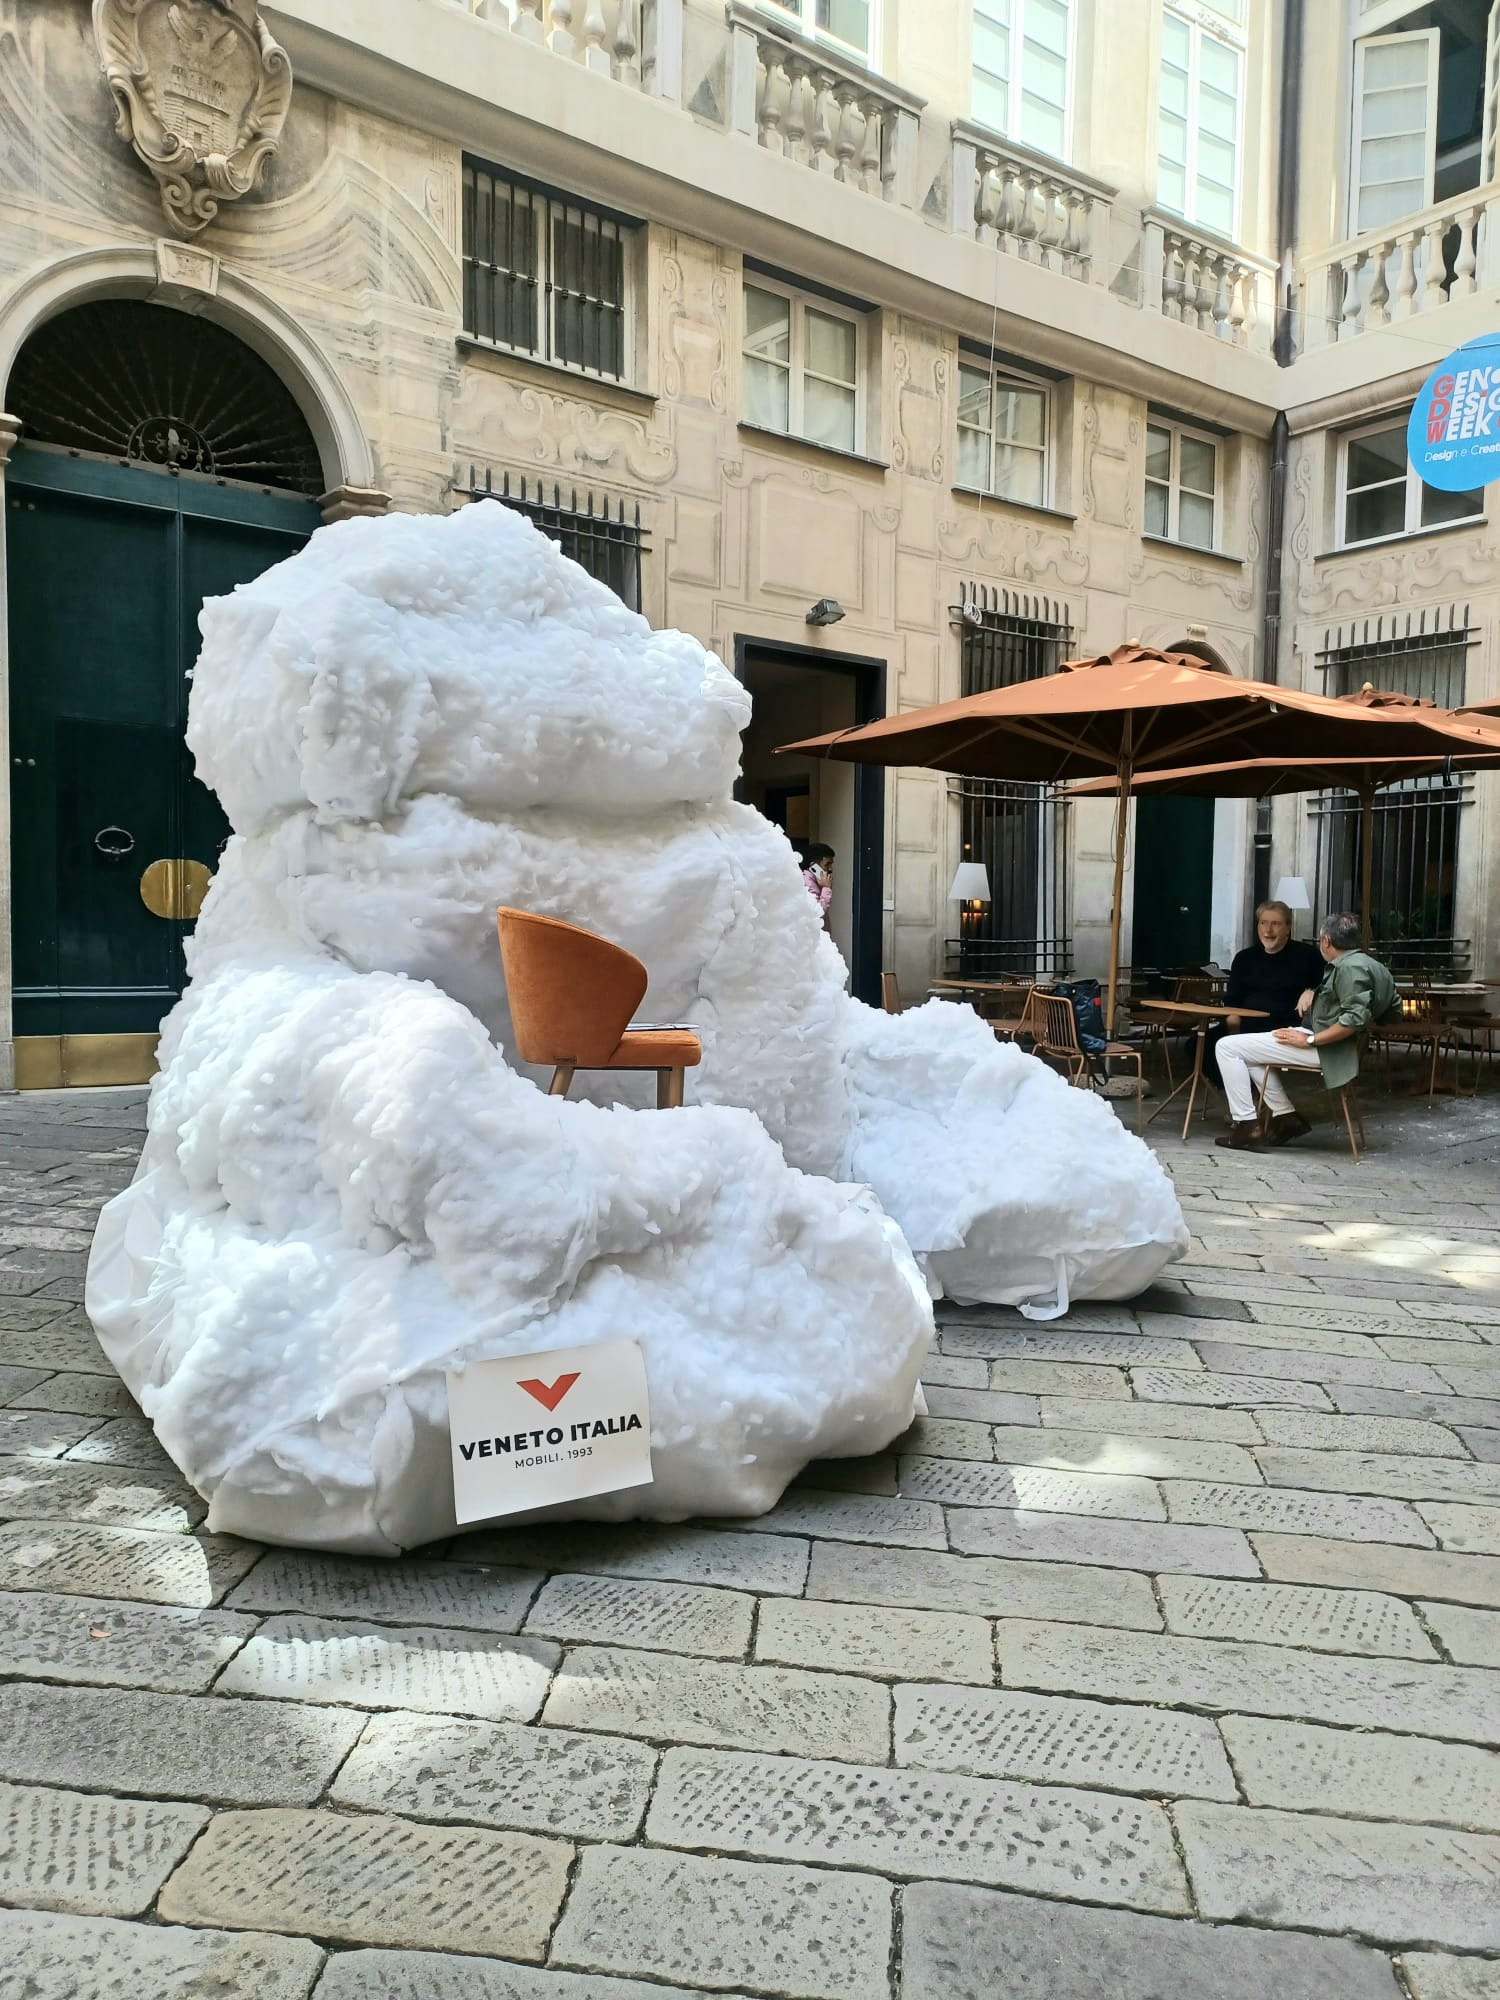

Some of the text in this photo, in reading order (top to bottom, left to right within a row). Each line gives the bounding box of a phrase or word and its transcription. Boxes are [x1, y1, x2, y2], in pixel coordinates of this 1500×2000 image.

[1427, 412, 1494, 444] WEEK
[1424, 449, 1458, 463] Design
[459, 1413, 642, 1461] VENETO ITALIA
[567, 1446, 593, 1460] 1993
